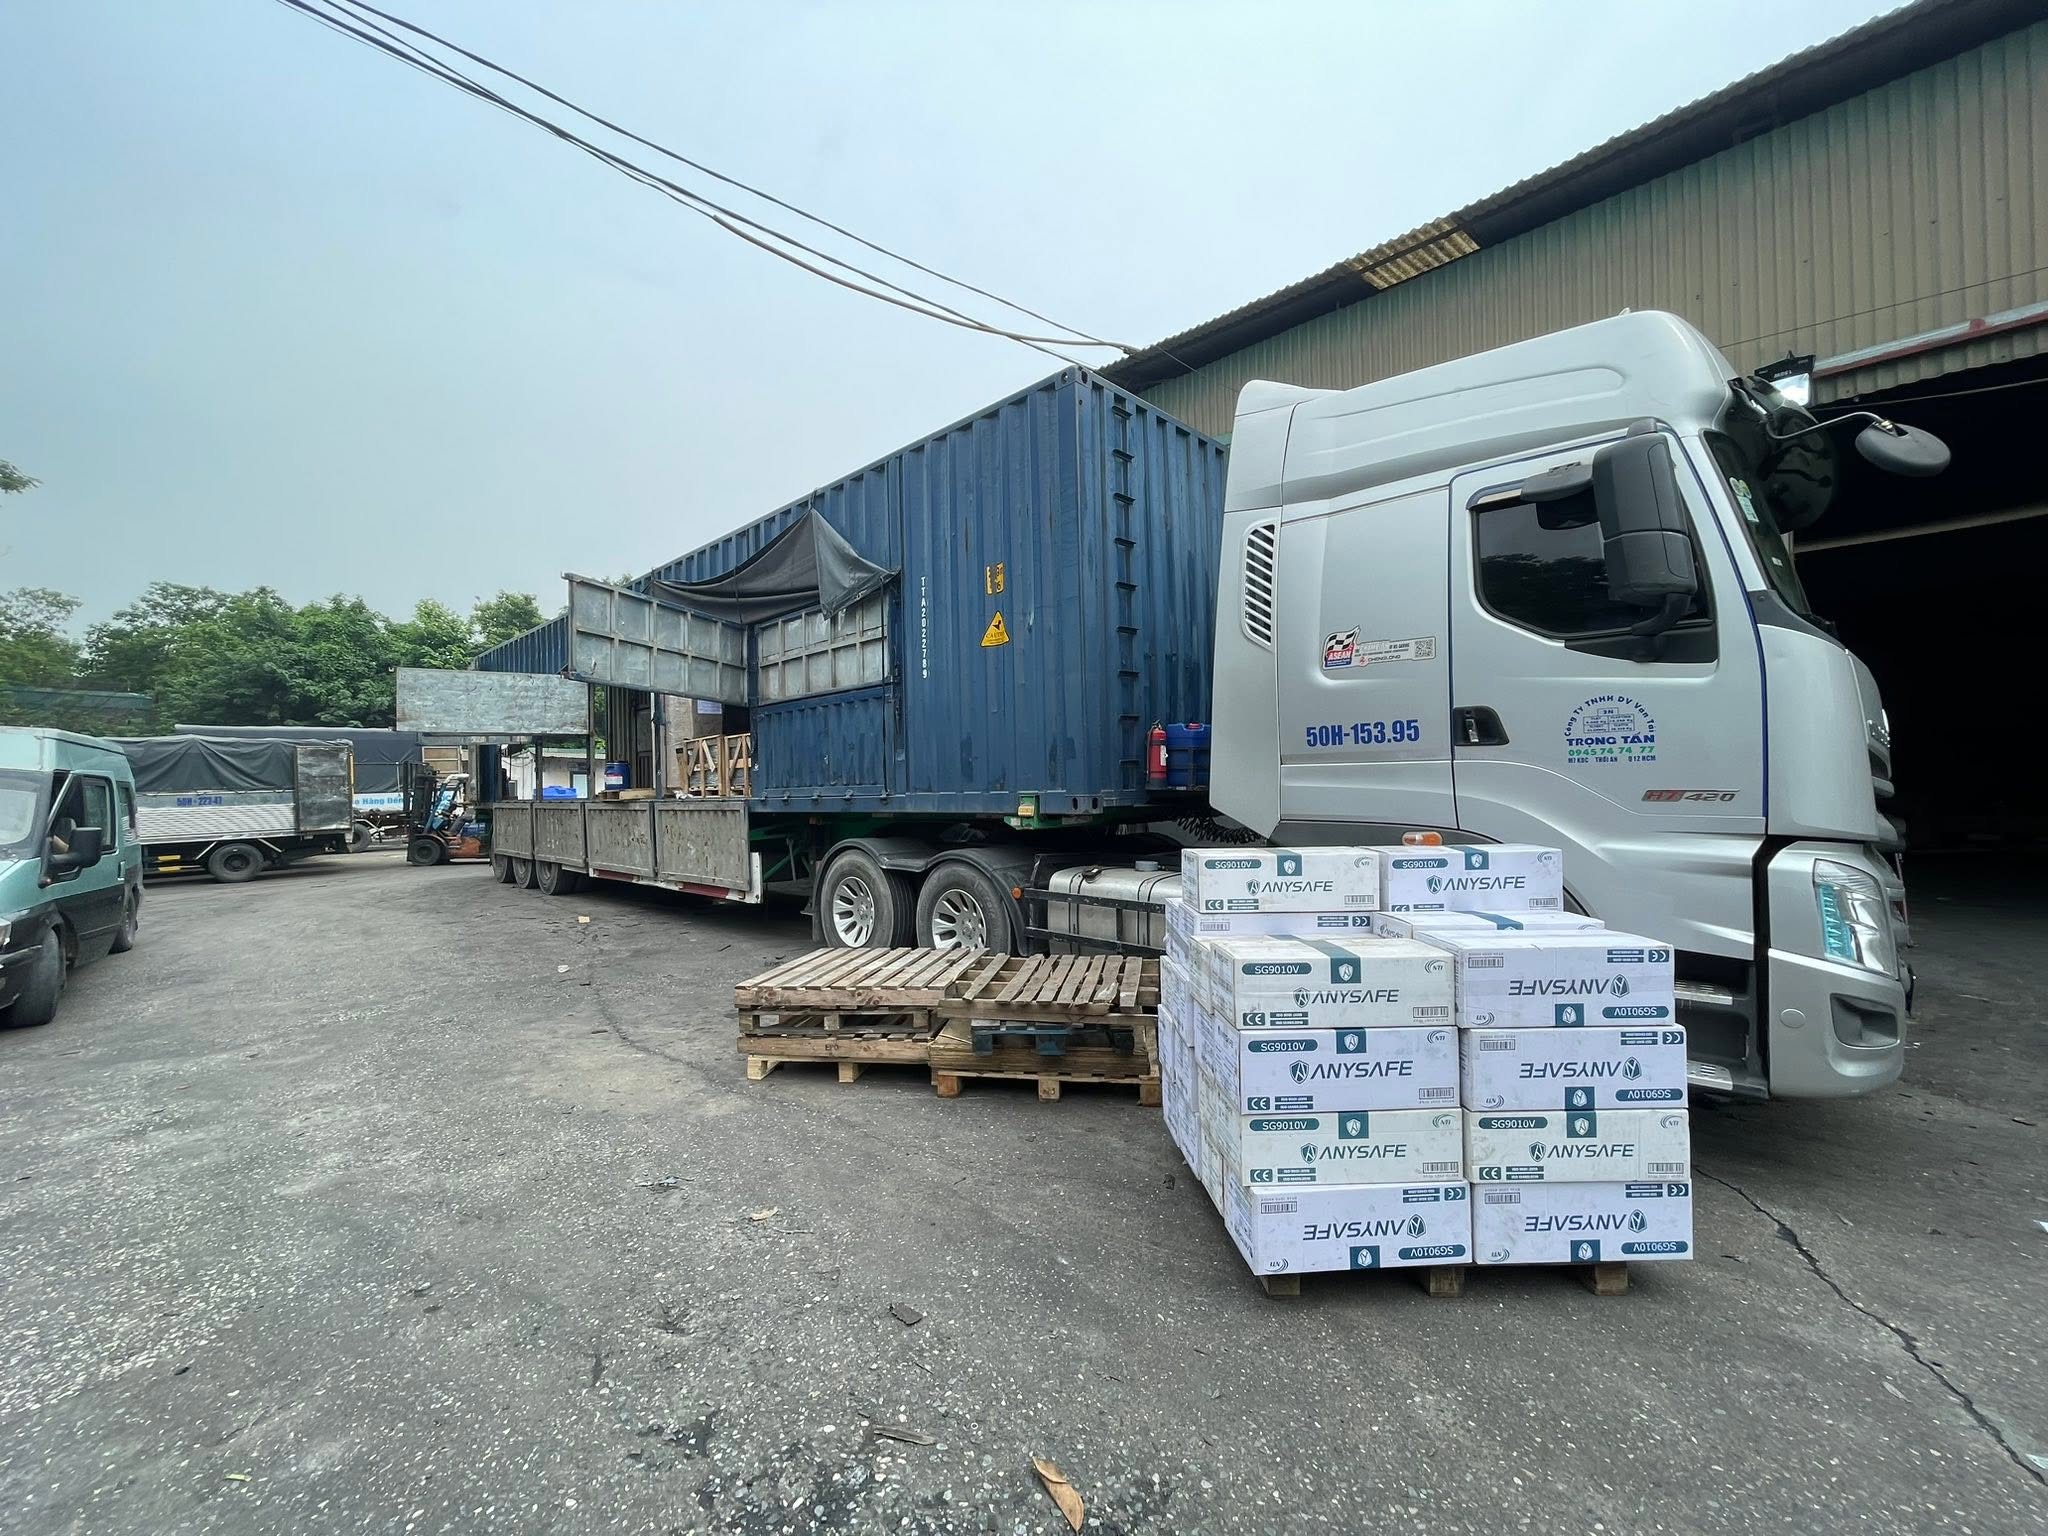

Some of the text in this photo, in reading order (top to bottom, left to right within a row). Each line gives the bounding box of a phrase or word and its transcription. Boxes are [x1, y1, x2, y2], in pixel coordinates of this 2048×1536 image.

[1584, 695, 1614, 707] TNHH
[1617, 695, 1633, 705] DV
[1306, 719, 1420, 747] 50H-153.95
[1568, 745, 1655, 757] 0945 74 74 77
[1685, 793, 1736, 801] 420
[1215, 860, 1252, 869] SG9010V
[1402, 860, 1439, 869] SG9010V
[1261, 880, 1334, 893] ANYSAFE
[1443, 876, 1526, 891] ANYSAFE
[1208, 900, 1221, 910] CE
[1355, 916, 1368, 926] CE
[1651, 950, 1666, 962] CE
[1254, 965, 1300, 974] SG9010V
[1508, 978, 1610, 996] ANYSAFE
[1311, 989, 1400, 1004] ANYSAFE
[1613, 1007, 1657, 1016] SG9010V
[1246, 1013, 1262, 1025] CE
[1665, 1032, 1680, 1043] CE
[1260, 1041, 1305, 1051] SG9010V
[1310, 1060, 1414, 1080] ANYSAFE
[1519, 1061, 1621, 1079] ANYSAFE
[1627, 1090, 1671, 1099] SG9010V
[1251, 1097, 1267, 1109] CE
[1262, 1121, 1307, 1130] SG9010V
[1491, 1120, 1536, 1128] SG9010V
[1318, 1144, 1407, 1160] ANYSAFE
[1547, 1144, 1635, 1159] ANYSAFE
[1253, 1169, 1269, 1182] CE
[1482, 1167, 1498, 1179] CE
[1447, 1188, 1463, 1199] CE
[1670, 1184, 1685, 1196] CE
[1524, 1214, 1627, 1232] ANYSAFE
[1302, 1219, 1406, 1241] ANYSAFE
[1410, 1246, 1454, 1257] SG9010V
[1633, 1242, 1677, 1251] SG9010V
